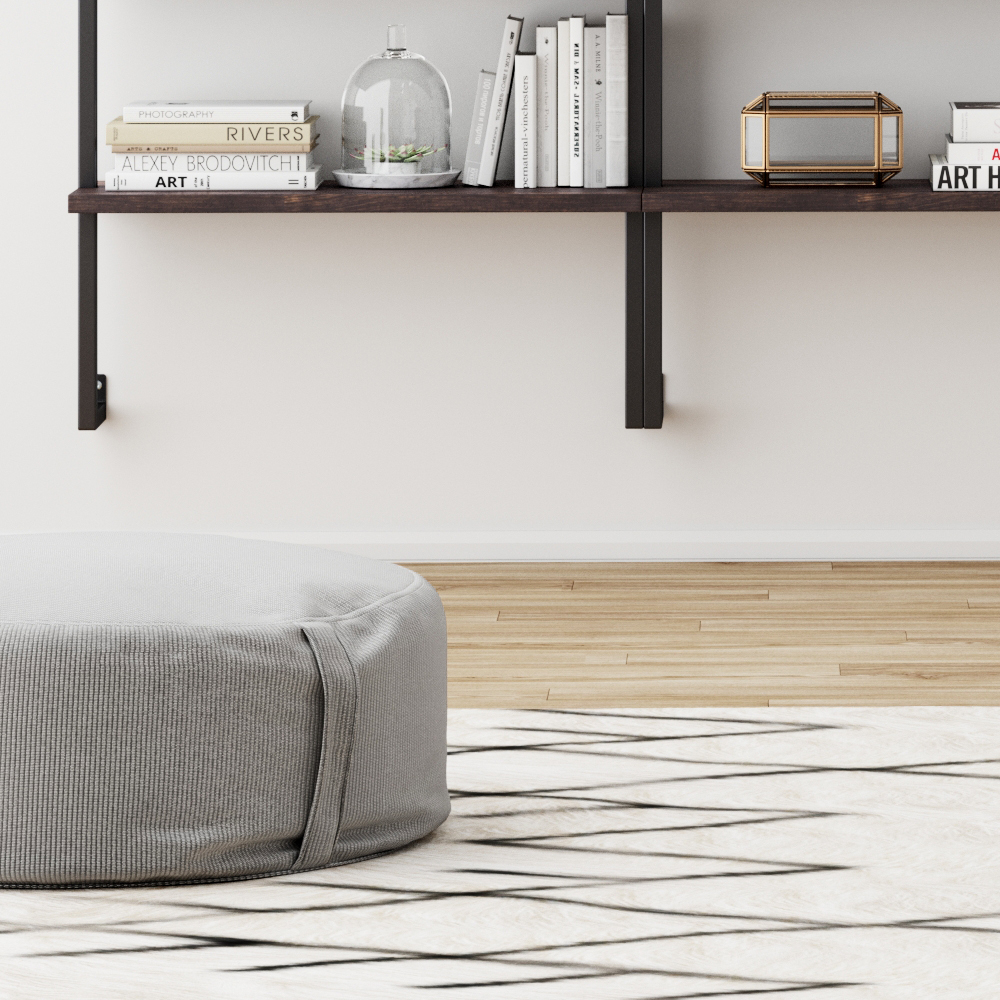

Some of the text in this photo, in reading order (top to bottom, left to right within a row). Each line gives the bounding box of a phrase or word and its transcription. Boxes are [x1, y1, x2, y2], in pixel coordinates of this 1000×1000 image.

[138, 110, 214, 119] PHOTOGRAPHY
[594, 92, 602, 152] Winnie-the-Pooh
[226, 126, 304, 142] RIVERS
[121, 155, 179, 172] ALEXEY
[187, 155, 292, 172] BRODOVITCH
[155, 176, 188, 188] ART
[937, 165, 982, 190] ART
